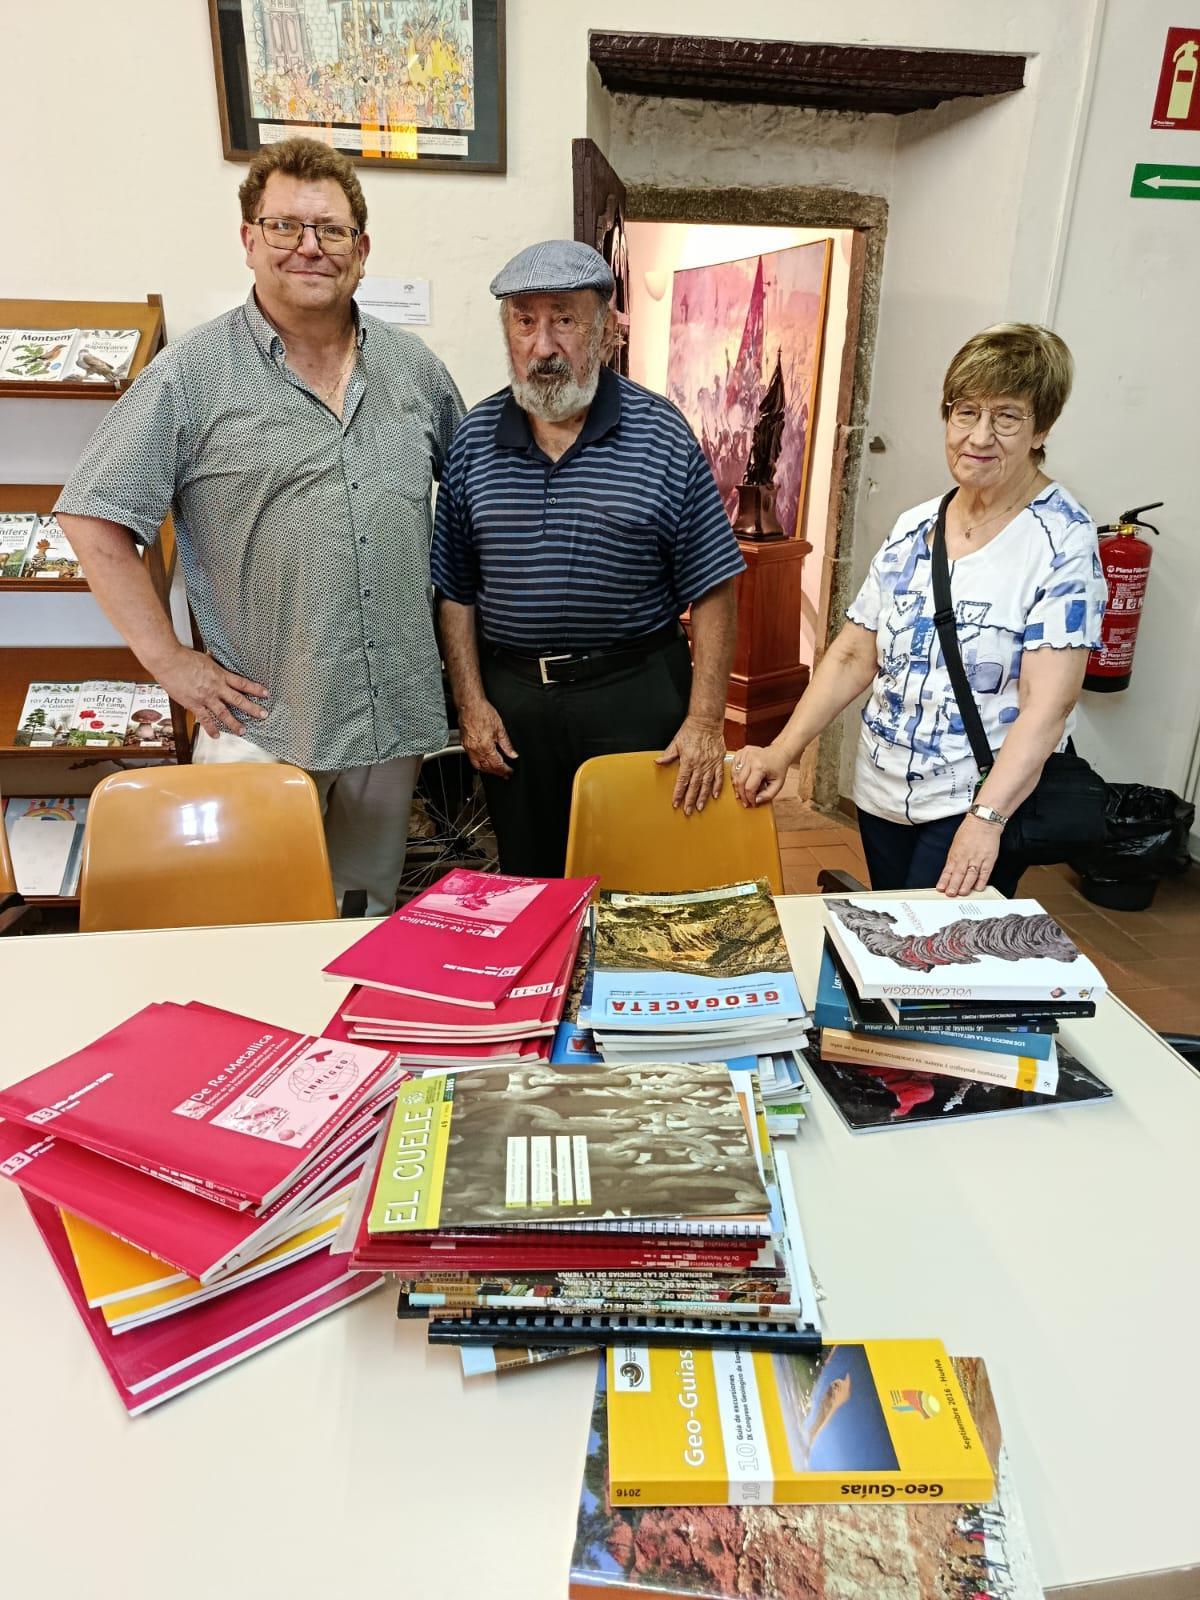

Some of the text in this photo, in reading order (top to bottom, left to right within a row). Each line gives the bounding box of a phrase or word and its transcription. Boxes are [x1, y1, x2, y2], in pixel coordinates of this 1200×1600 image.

[21, 334, 73, 342] Montseny
[97, 694, 122, 703] Flors
[398, 914, 446, 929] Metallica
[514, 985, 550, 996] 10-11
[611, 990, 778, 1011] GEOGACETA
[190, 1034, 273, 1101] De Re Metallica
[303, 1057, 348, 1094] INHIGEO
[31, 1108, 54, 1120] 13
[2, 1154, 25, 1171] 13
[384, 1190, 420, 1224] EL
[737, 1364, 743, 1372] de
[934, 1358, 947, 1383] Huelva
[729, 1374, 740, 1412] excursiones
[738, 1373, 748, 1403] Geológico
[678, 1346, 705, 1468] Geo-Guías
[735, 1413, 741, 1423] de
[743, 1403, 752, 1433] Congreso
[951, 1406, 972, 1450] Septiembre
[736, 1443, 760, 1471] 10
[616, 1488, 641, 1497] 2016
[743, 1482, 760, 1500] 10
[840, 1483, 944, 1499] Geo-Guías
